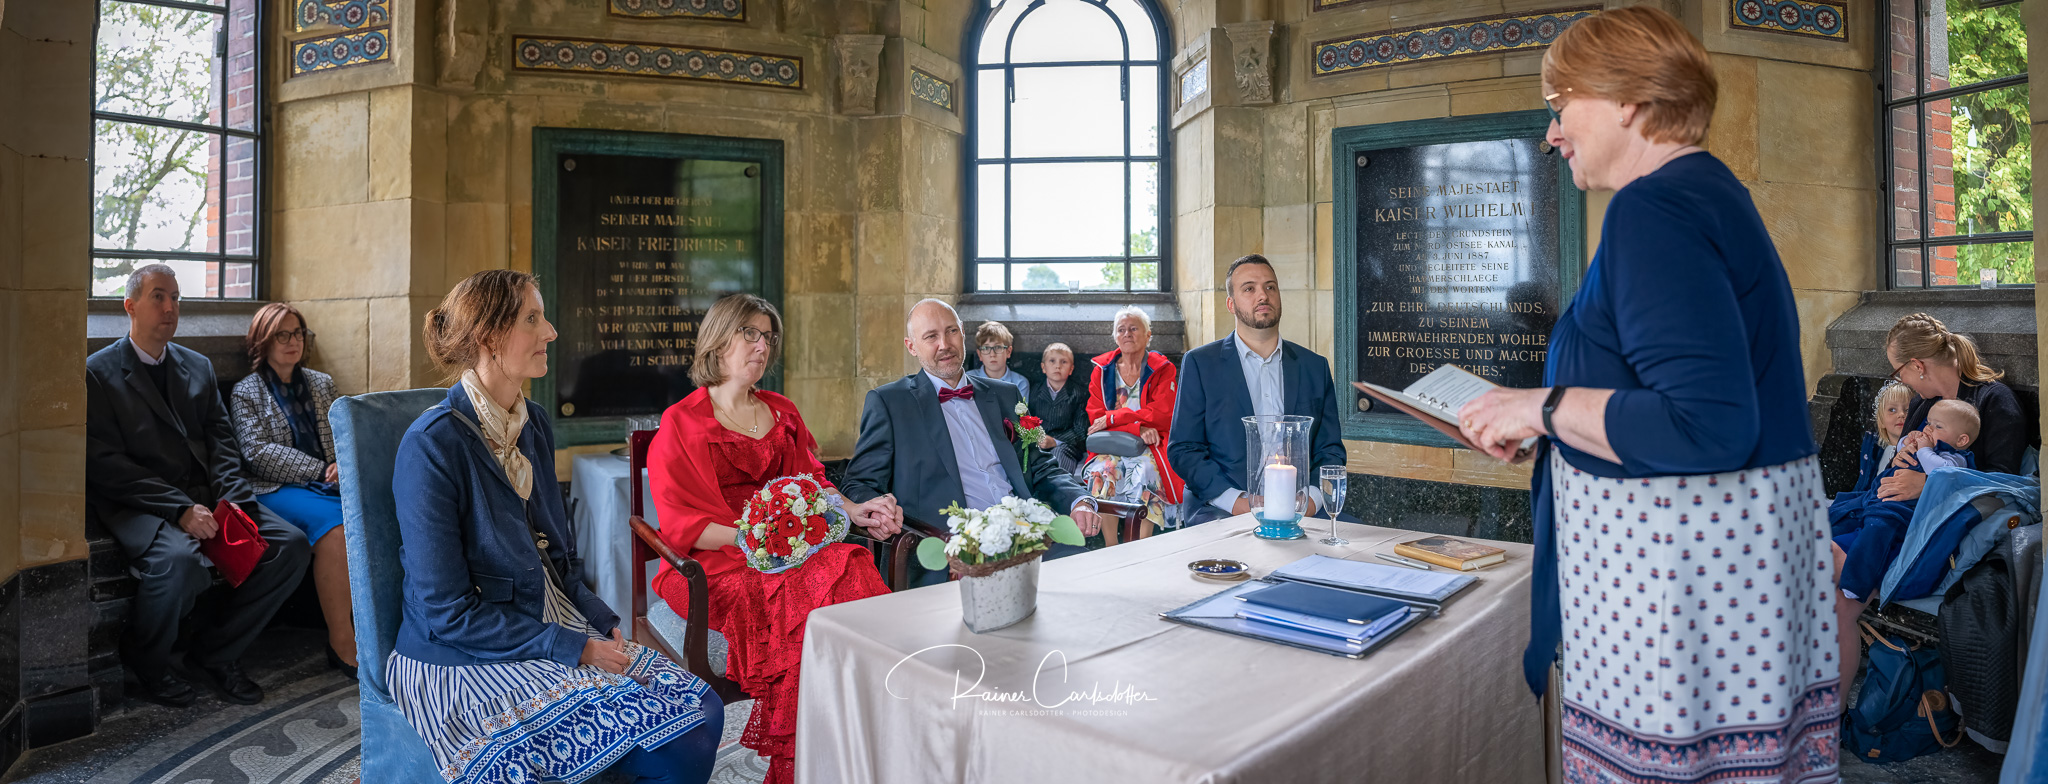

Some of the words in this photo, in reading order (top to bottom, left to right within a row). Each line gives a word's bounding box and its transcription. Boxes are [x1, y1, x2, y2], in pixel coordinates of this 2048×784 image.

[1436, 181, 1520, 197] MAJESTAET
[1443, 202, 1525, 219] WILHELM
[601, 214, 649, 226] SEINER
[577, 236, 632, 251] KAISER
[1442, 252, 1464, 260] JUNI
[1467, 251, 1490, 260] 1887
[1399, 264, 1417, 272] UND
[1481, 262, 1510, 271] SEINE
[1418, 318, 1434, 328] ZU
[1440, 318, 1490, 329] SEINEM
[1368, 331, 1495, 345] IMMERWAEHRENDEN
[1367, 346, 1390, 357] ZUR
[1466, 349, 1494, 360] UND
[1499, 350, 1547, 362] MACHT
